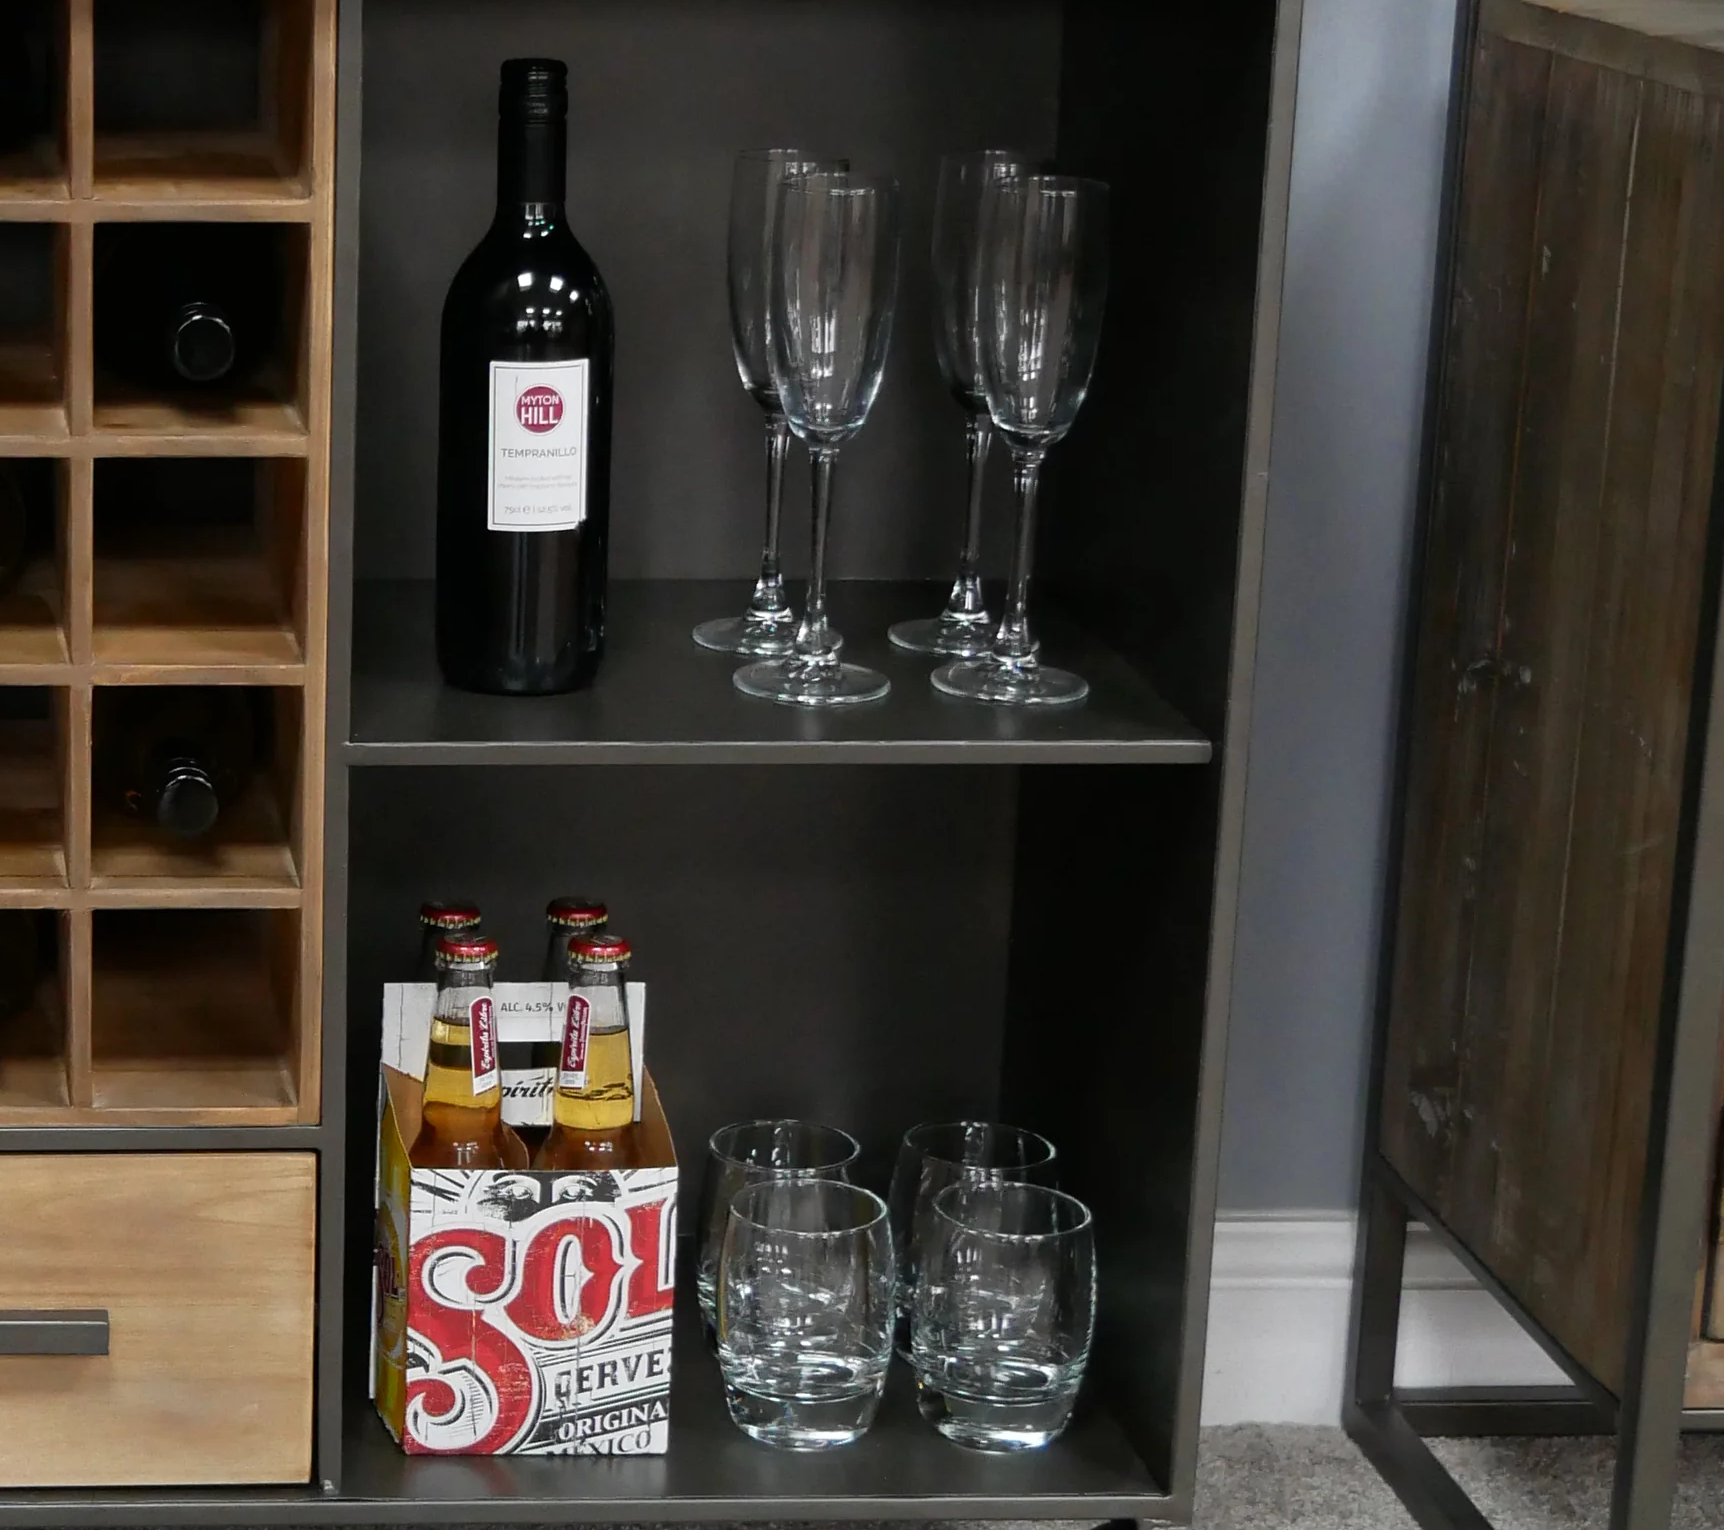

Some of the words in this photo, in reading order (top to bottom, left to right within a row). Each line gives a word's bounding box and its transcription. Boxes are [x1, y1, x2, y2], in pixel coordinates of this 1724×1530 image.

[521, 395, 560, 405] MYTON
[521, 406, 559, 424] HILL
[501, 447, 577, 458] TEMPRANILLO
[525, 1002, 553, 1012] 4.5%
[406, 1197, 674, 1454] SOL
[555, 1347, 671, 1399] CERVE
